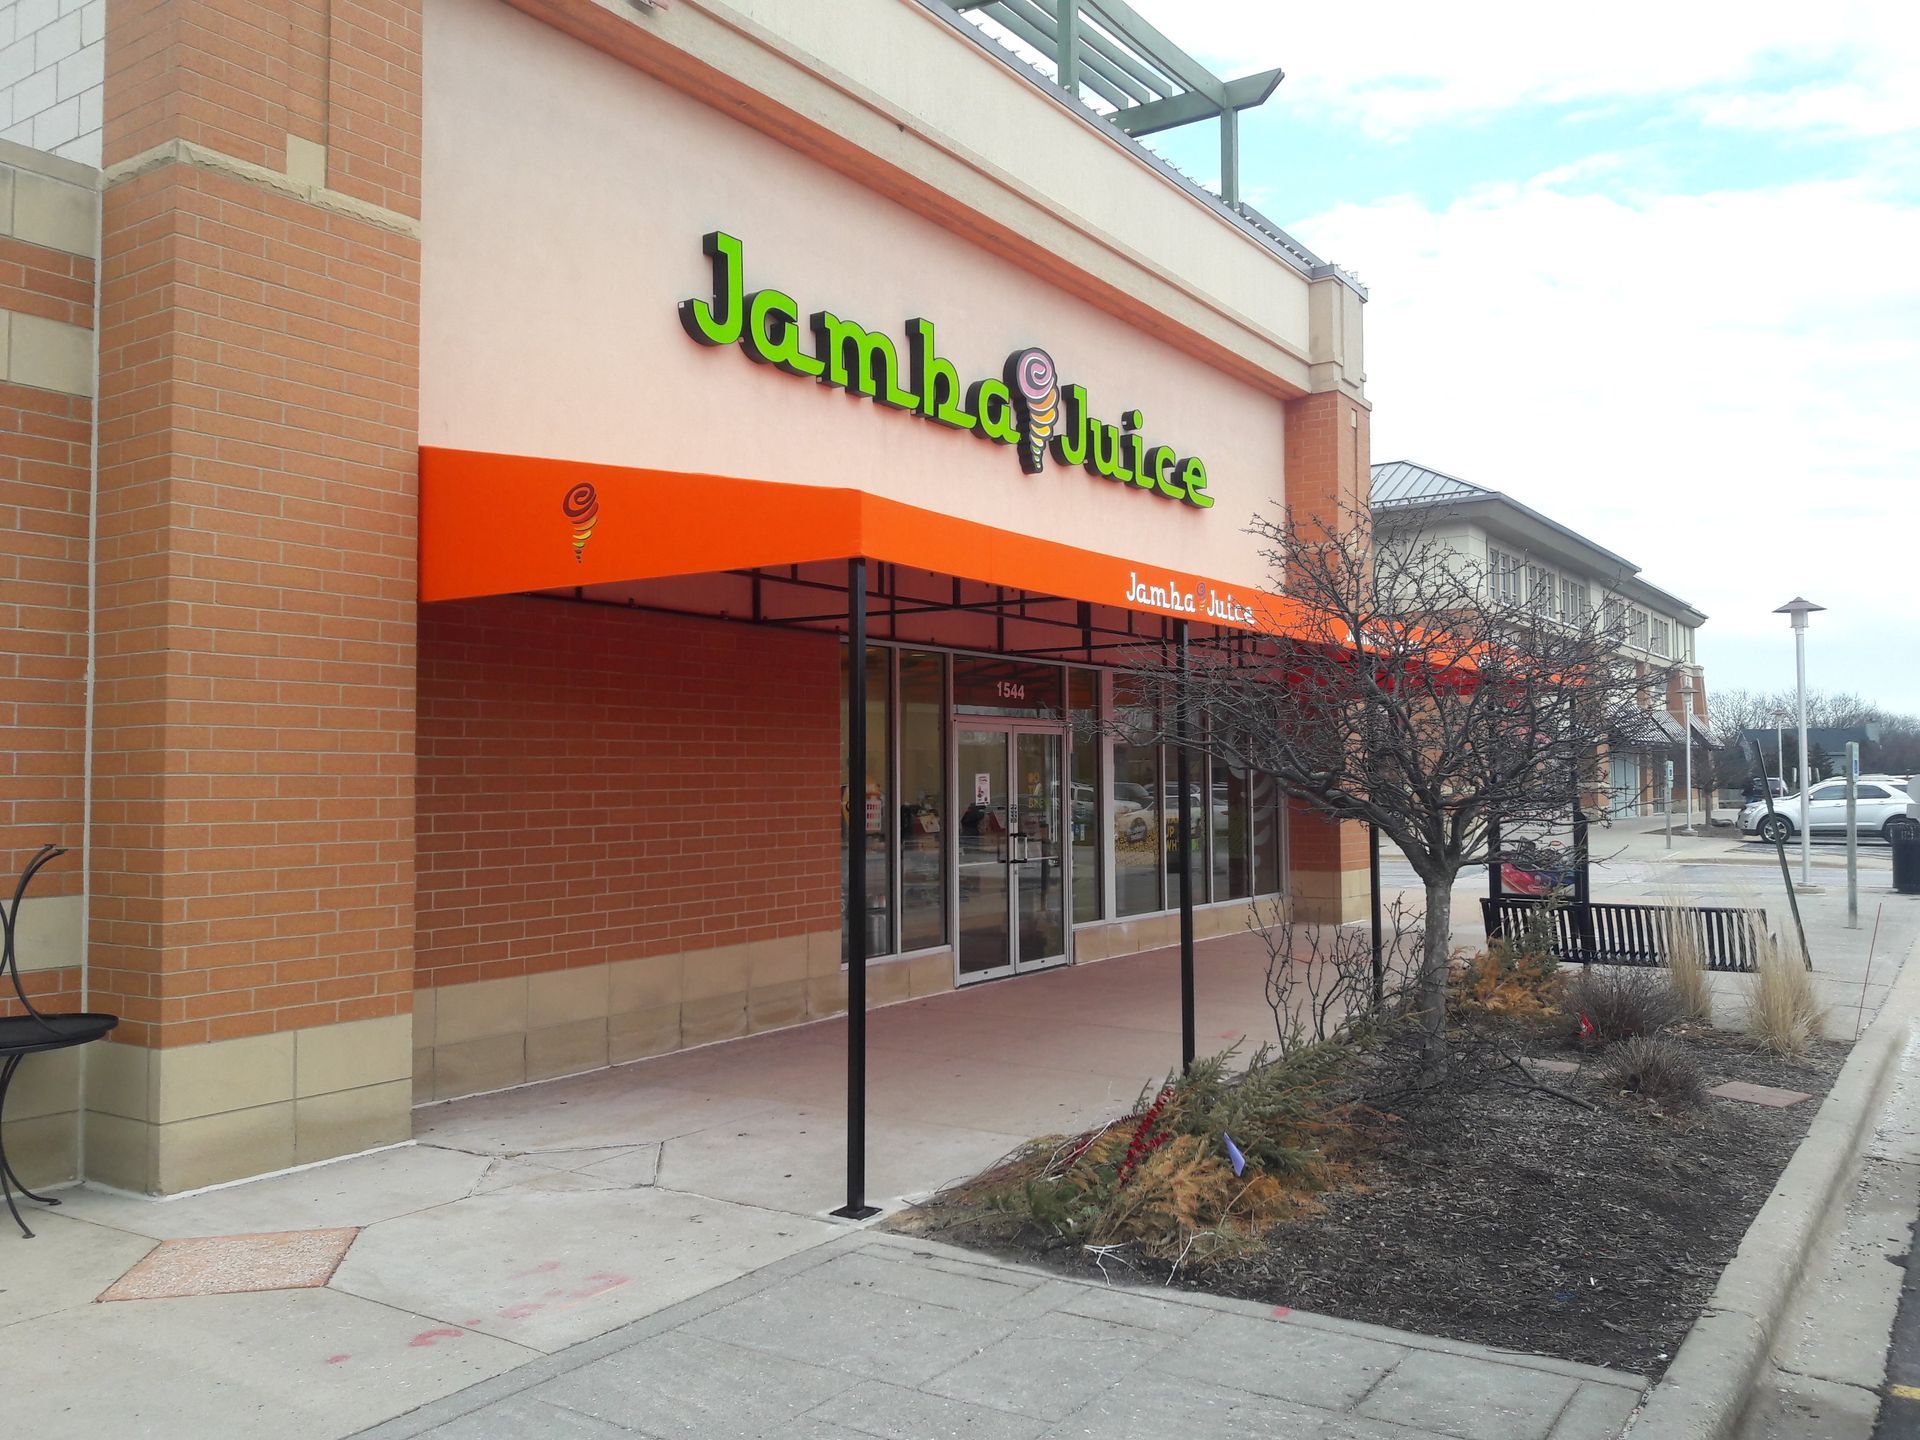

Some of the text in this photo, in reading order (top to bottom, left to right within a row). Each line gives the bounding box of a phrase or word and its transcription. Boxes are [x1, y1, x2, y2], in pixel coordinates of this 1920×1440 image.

[680, 231, 1215, 509] Jamba Juice
[1126, 571, 1256, 625] Jamba Juice
[996, 681, 1025, 700] 1544
